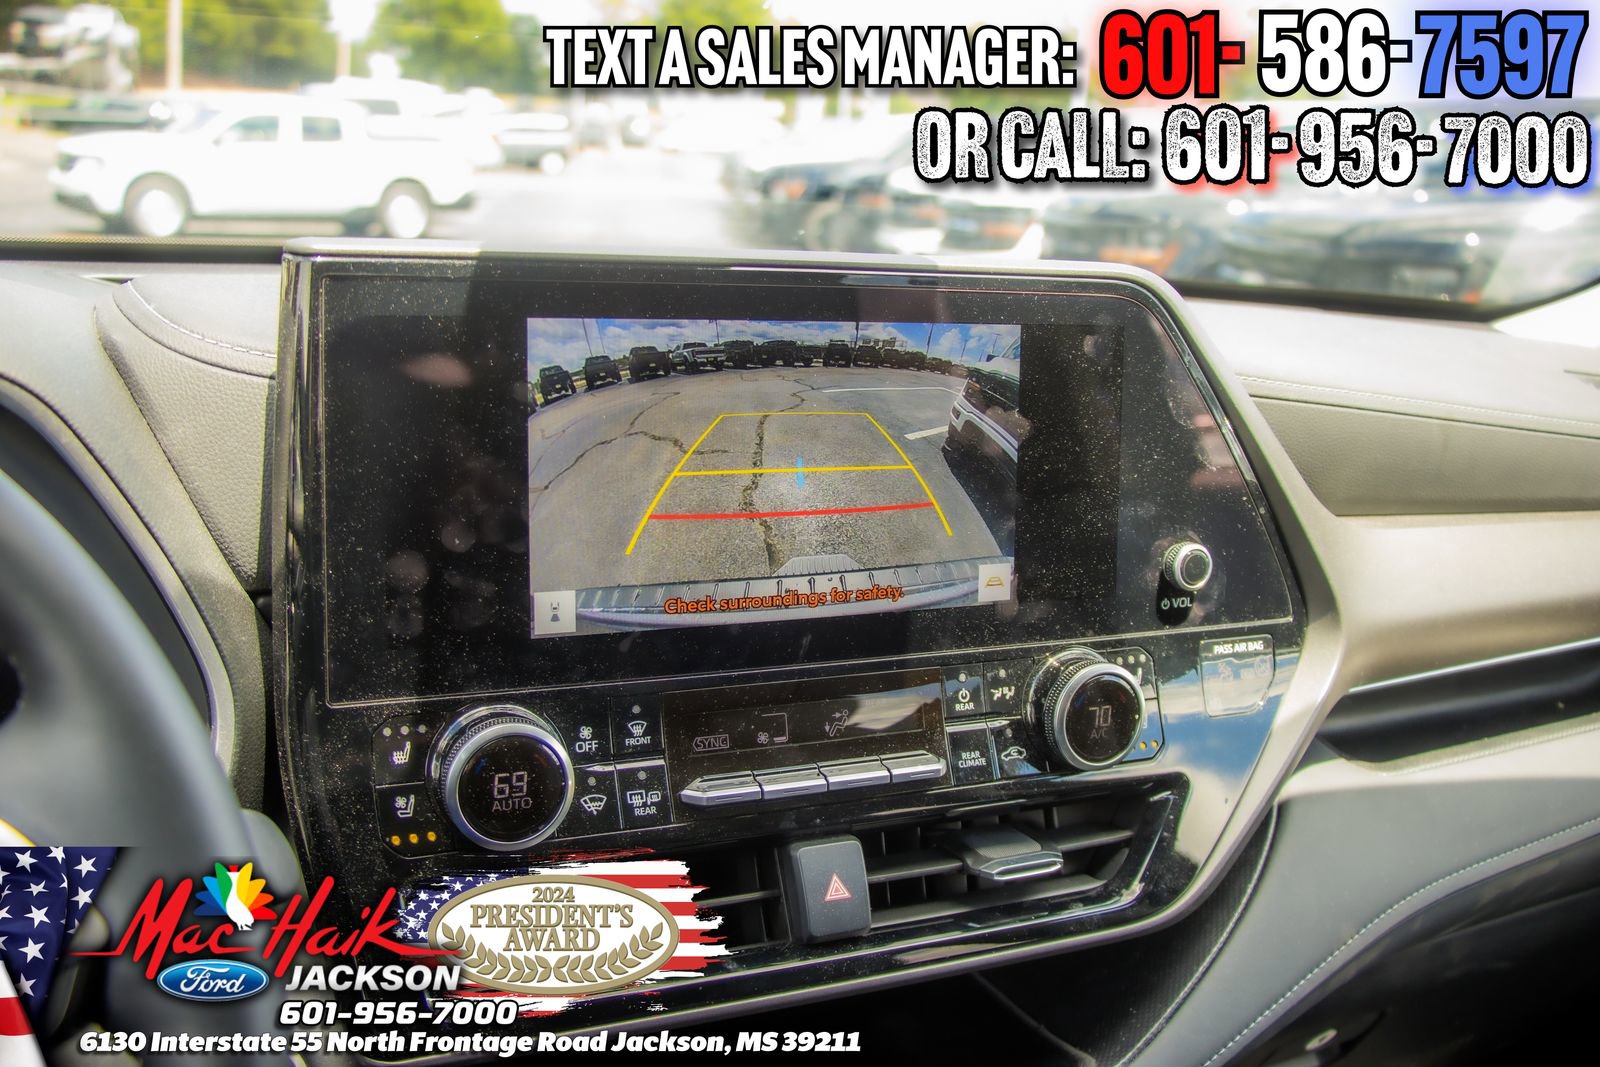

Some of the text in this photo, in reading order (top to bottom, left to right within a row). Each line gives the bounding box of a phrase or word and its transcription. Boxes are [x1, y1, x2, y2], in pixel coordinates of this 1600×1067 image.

[664, 584, 906, 615] Check surroundings for safety.
[1172, 596, 1193, 608] VOL
[1213, 640, 1264, 655] PASS AIR BAG
[955, 701, 975, 712] REAR
[1089, 704, 1112, 728] 70
[575, 740, 599, 754] OFF
[625, 736, 652, 747] FRONT
[695, 735, 728, 749] SYNC
[961, 750, 981, 760] REAR
[958, 758, 988, 769] CLIMATE
[494, 771, 528, 799] 69
[491, 797, 533, 813] AUTO
[634, 805, 658, 817] REAR
